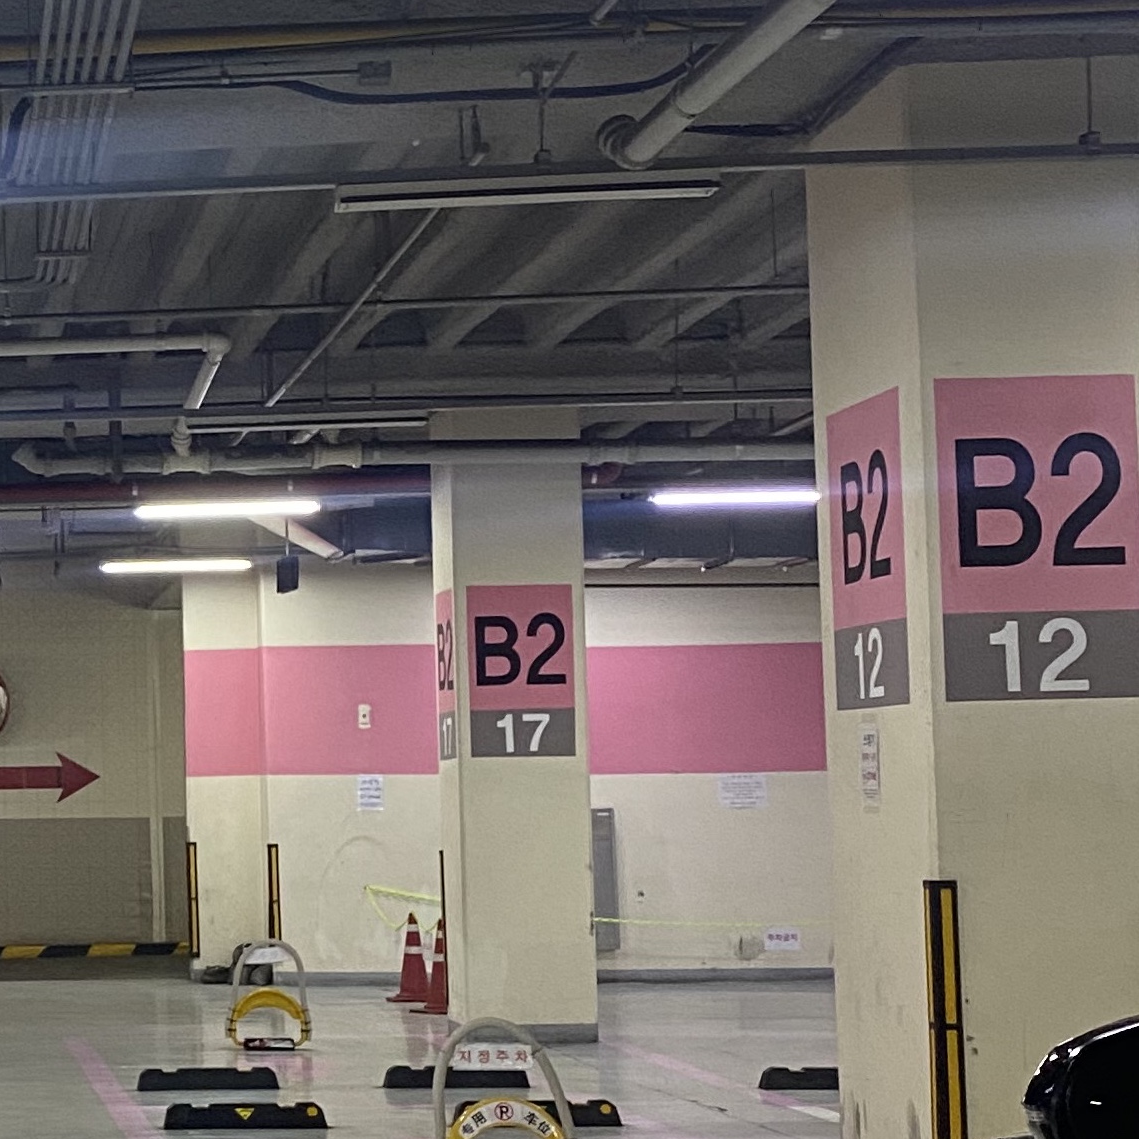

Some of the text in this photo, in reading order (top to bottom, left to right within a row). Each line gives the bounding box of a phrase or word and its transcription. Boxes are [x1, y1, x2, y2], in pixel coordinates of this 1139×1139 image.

[840, 449, 891, 585] B2
[955, 432, 1126, 568] B2
[437, 619, 454, 690] B2
[474, 612, 567, 686] B2
[854, 627, 885, 699] 12
[989, 618, 1090, 692] 12
[442, 717, 452, 756] 17
[496, 713, 550, 753] 17
[457, 1050, 529, 1064] 지정주차
